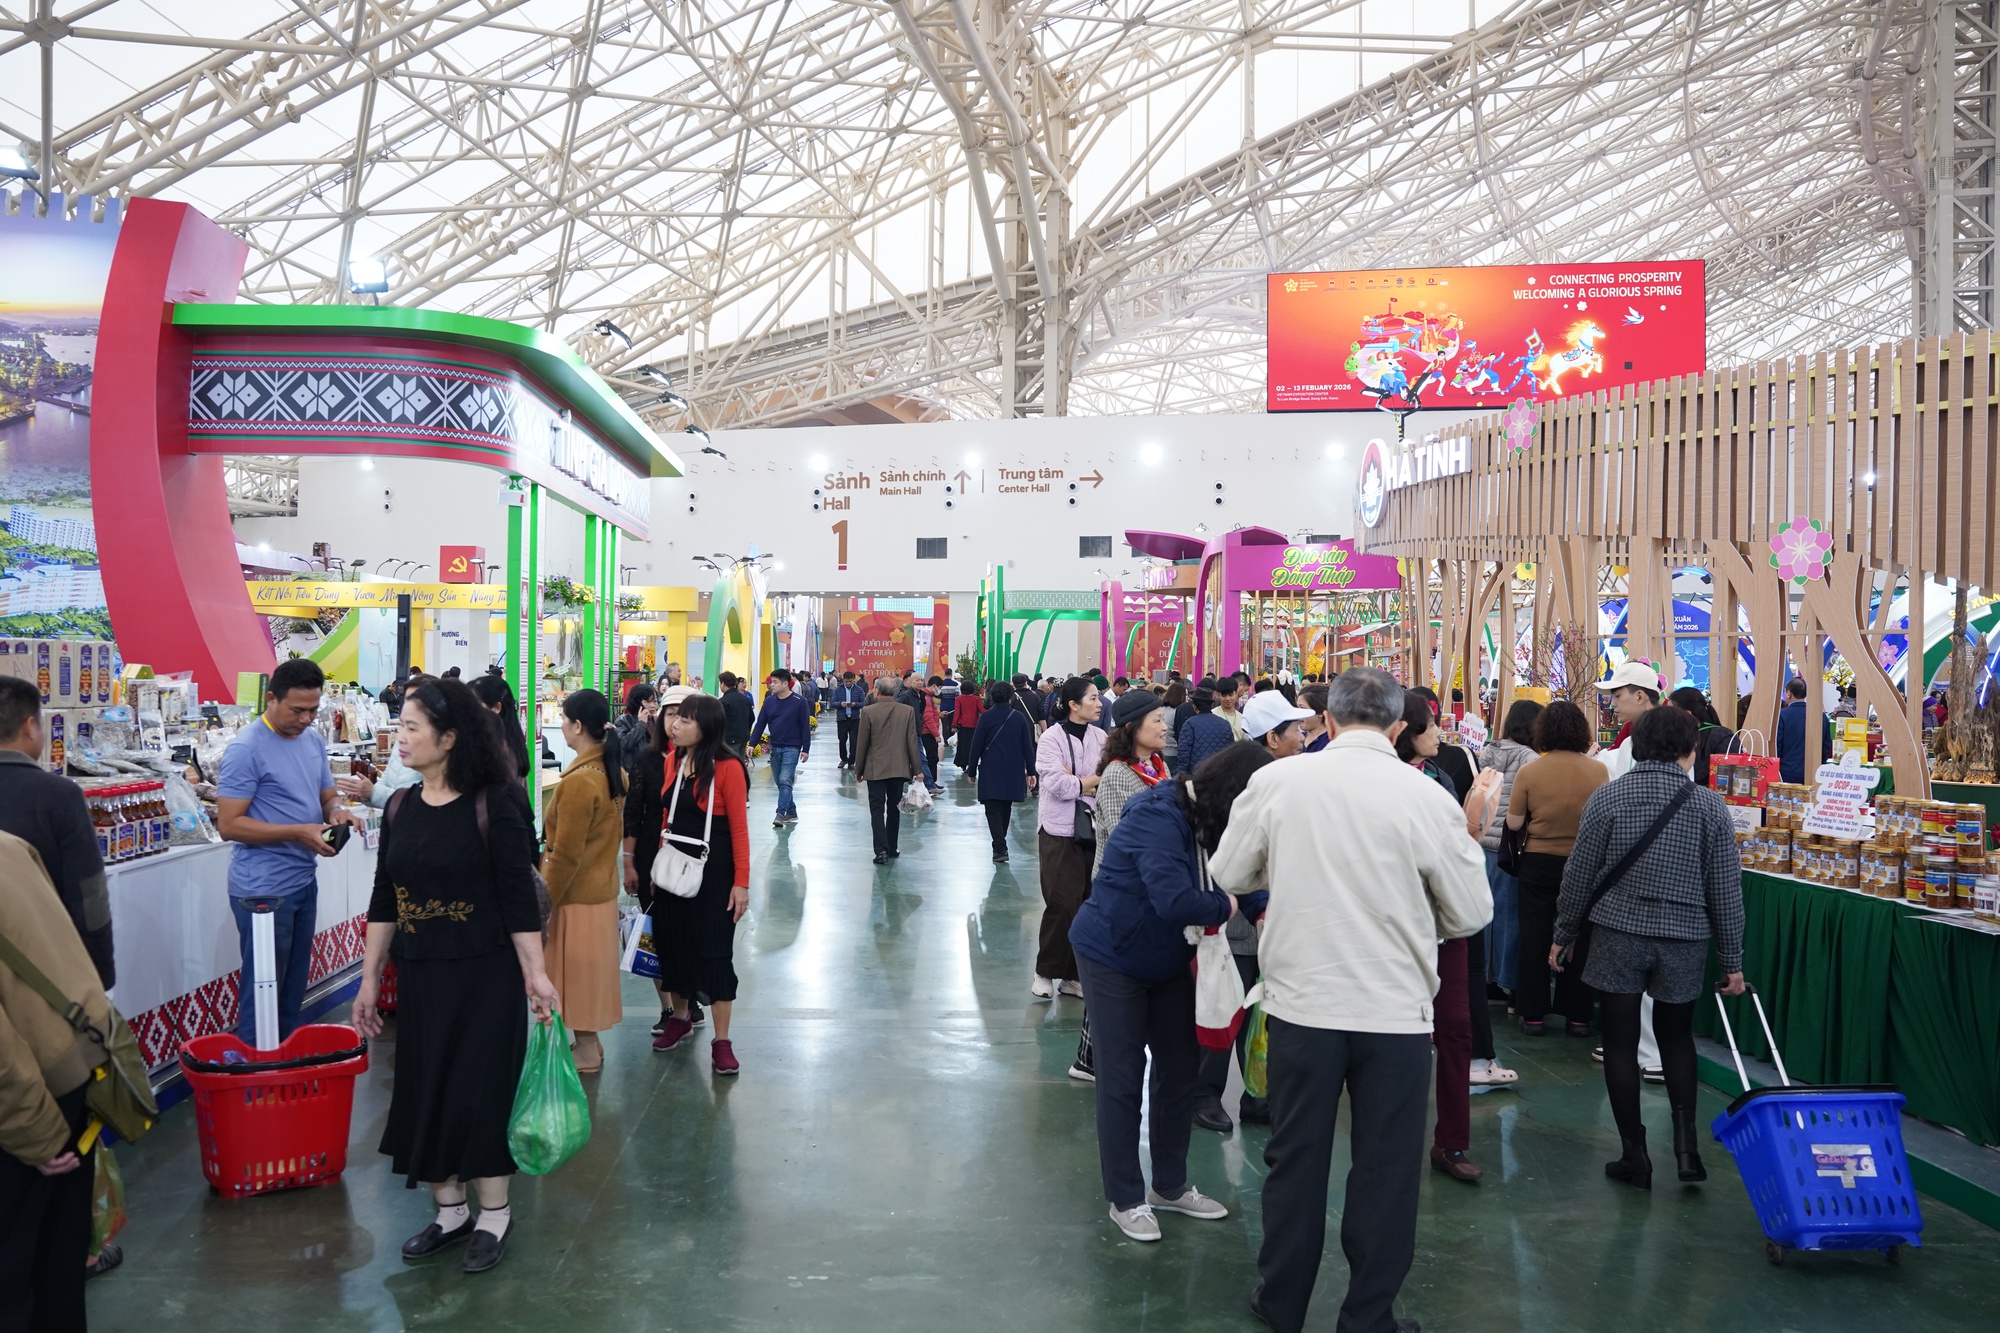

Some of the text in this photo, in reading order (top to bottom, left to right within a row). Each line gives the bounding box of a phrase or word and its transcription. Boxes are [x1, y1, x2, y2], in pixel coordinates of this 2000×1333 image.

[1550, 272, 1682, 285] CONNECTING PROSPERITY
[1513, 285, 1682, 299] WELCOMING A GLORIOUS SPRING
[823, 471, 871, 491] Sảnh
[880, 469, 946, 483] Sảnh chính
[999, 467, 1064, 482] Trung tâm
[879, 486, 922, 496] Main Hall
[998, 483, 1050, 493] Center Hall
[823, 496, 850, 511] Hall
[831, 519, 848, 564] 1
[1319, 545, 1348, 564] sản
[1271, 565, 1355, 588] Đồng Tháp
[314, 587, 340, 604] Dùng
[411, 588, 434, 605] Nông
[861, 638, 880, 647] XUÂN
[858, 647, 871, 656] TẾT
[1460, 725, 1469, 736] TEAM
[1834, 780, 1850, 789] OCOP
